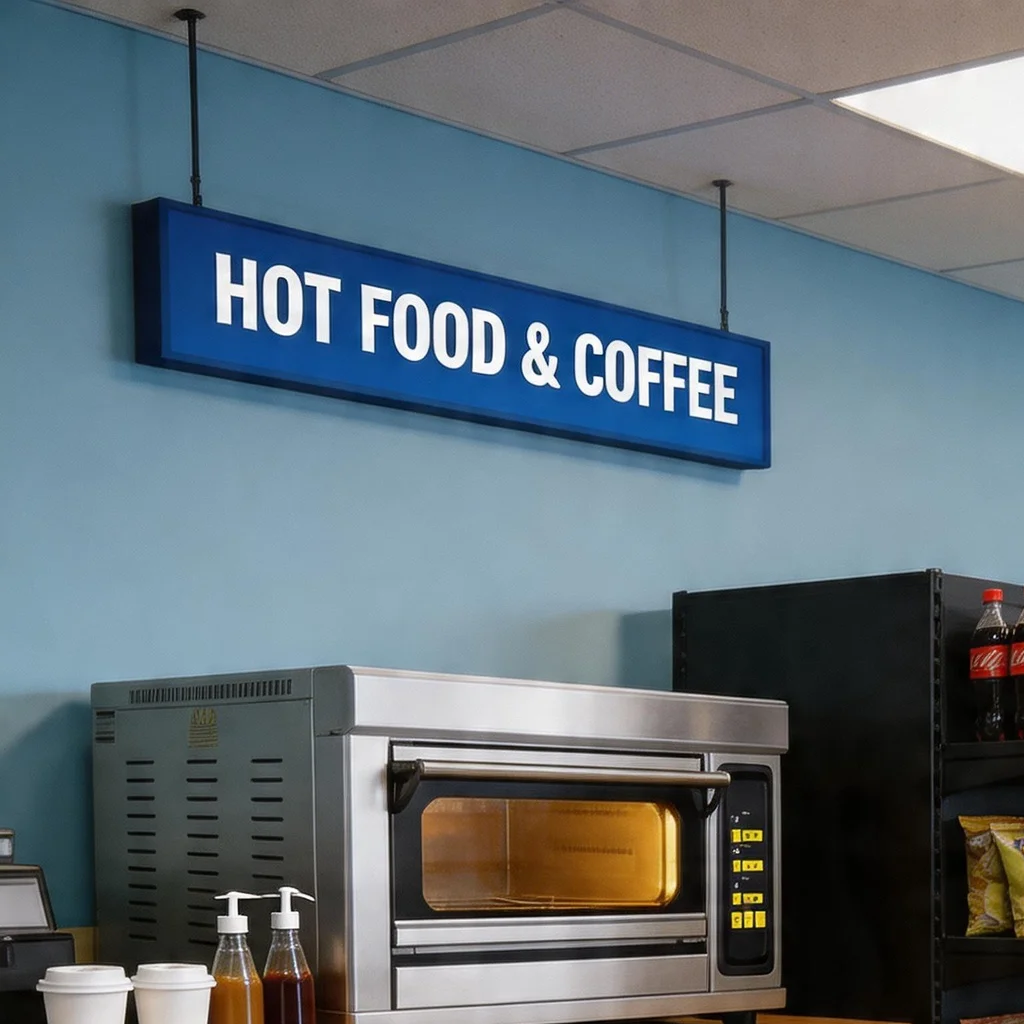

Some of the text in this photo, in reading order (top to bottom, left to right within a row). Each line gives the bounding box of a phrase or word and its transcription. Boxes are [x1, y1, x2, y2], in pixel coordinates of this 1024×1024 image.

[215, 252, 738, 425] HOT FOOD & COFFEE
